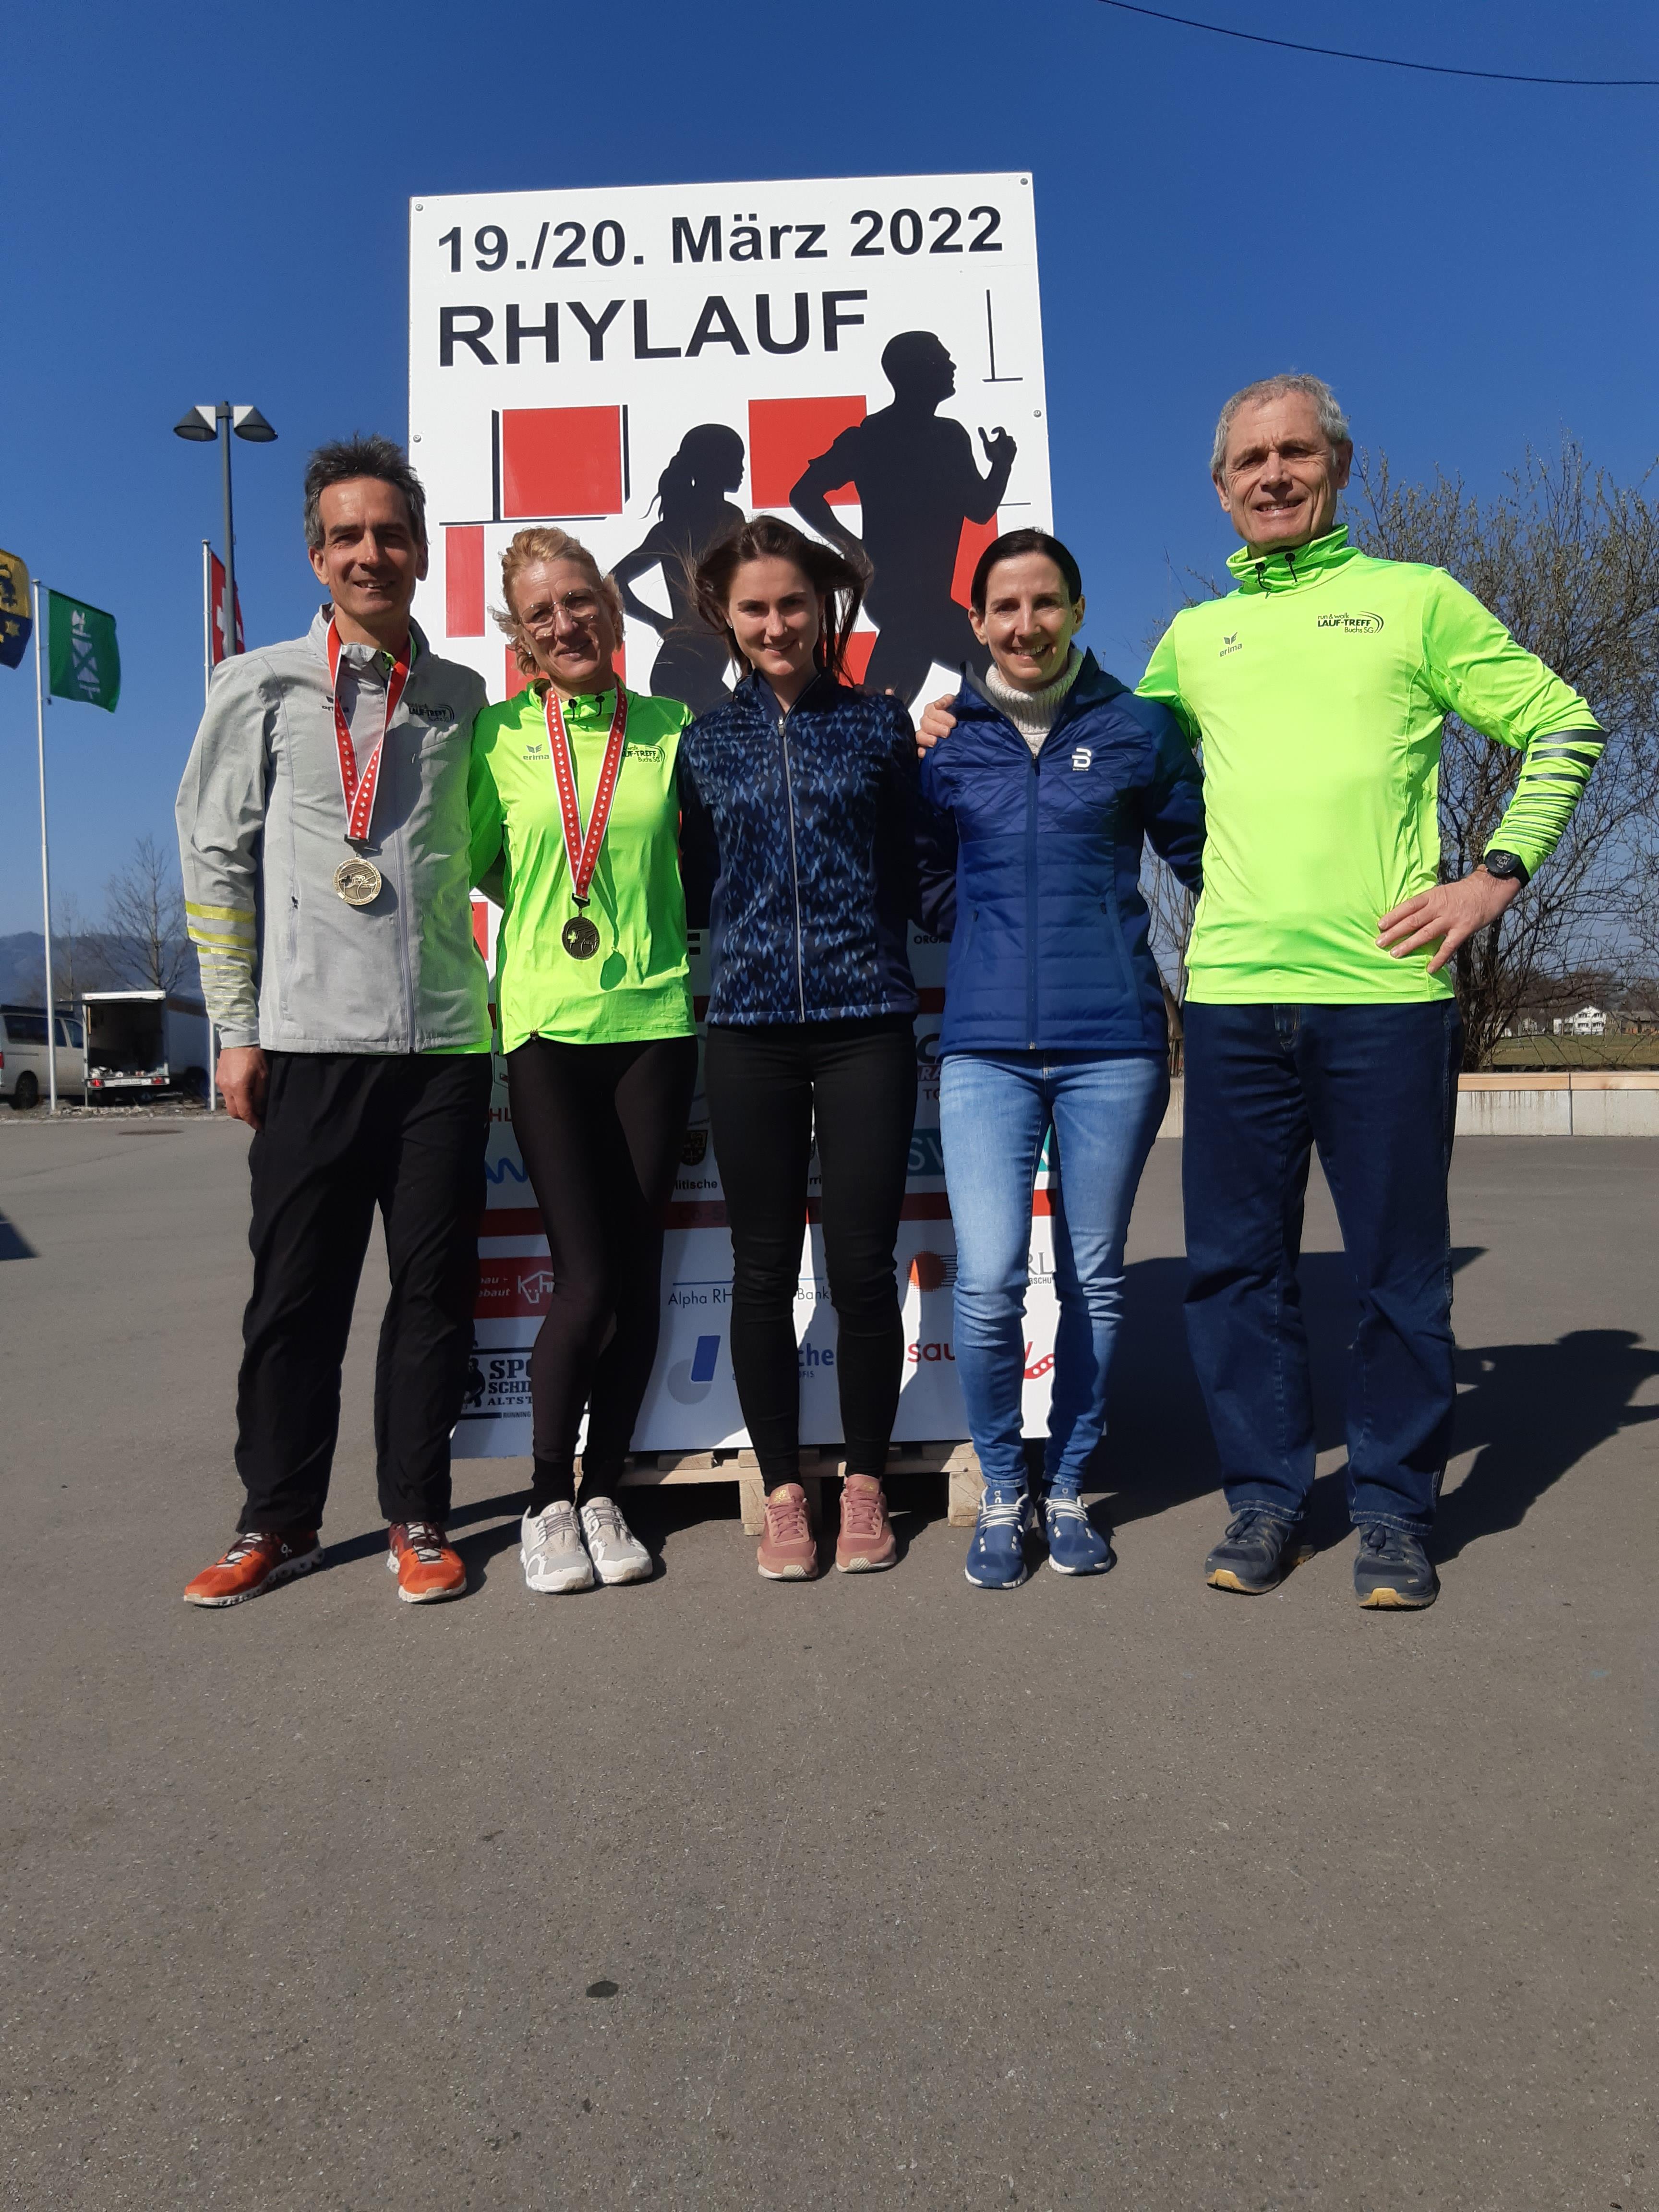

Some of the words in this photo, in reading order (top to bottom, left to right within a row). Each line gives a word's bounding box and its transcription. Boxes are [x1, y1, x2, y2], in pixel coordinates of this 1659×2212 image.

[438, 220, 645, 273] 19./20.
[672, 213, 828, 263] März
[850, 205, 1003, 259] 2022
[439, 289, 868, 367] RHYLAUF
[1318, 619, 1371, 627] LAUF-TREFF
[1220, 643, 1242, 657] erima
[914, 936, 944, 944] ORG
[668, 1290, 708, 1309] Alpha
[797, 1286, 830, 1300] Bank
[503, 1411, 531, 1419] RUNNING
